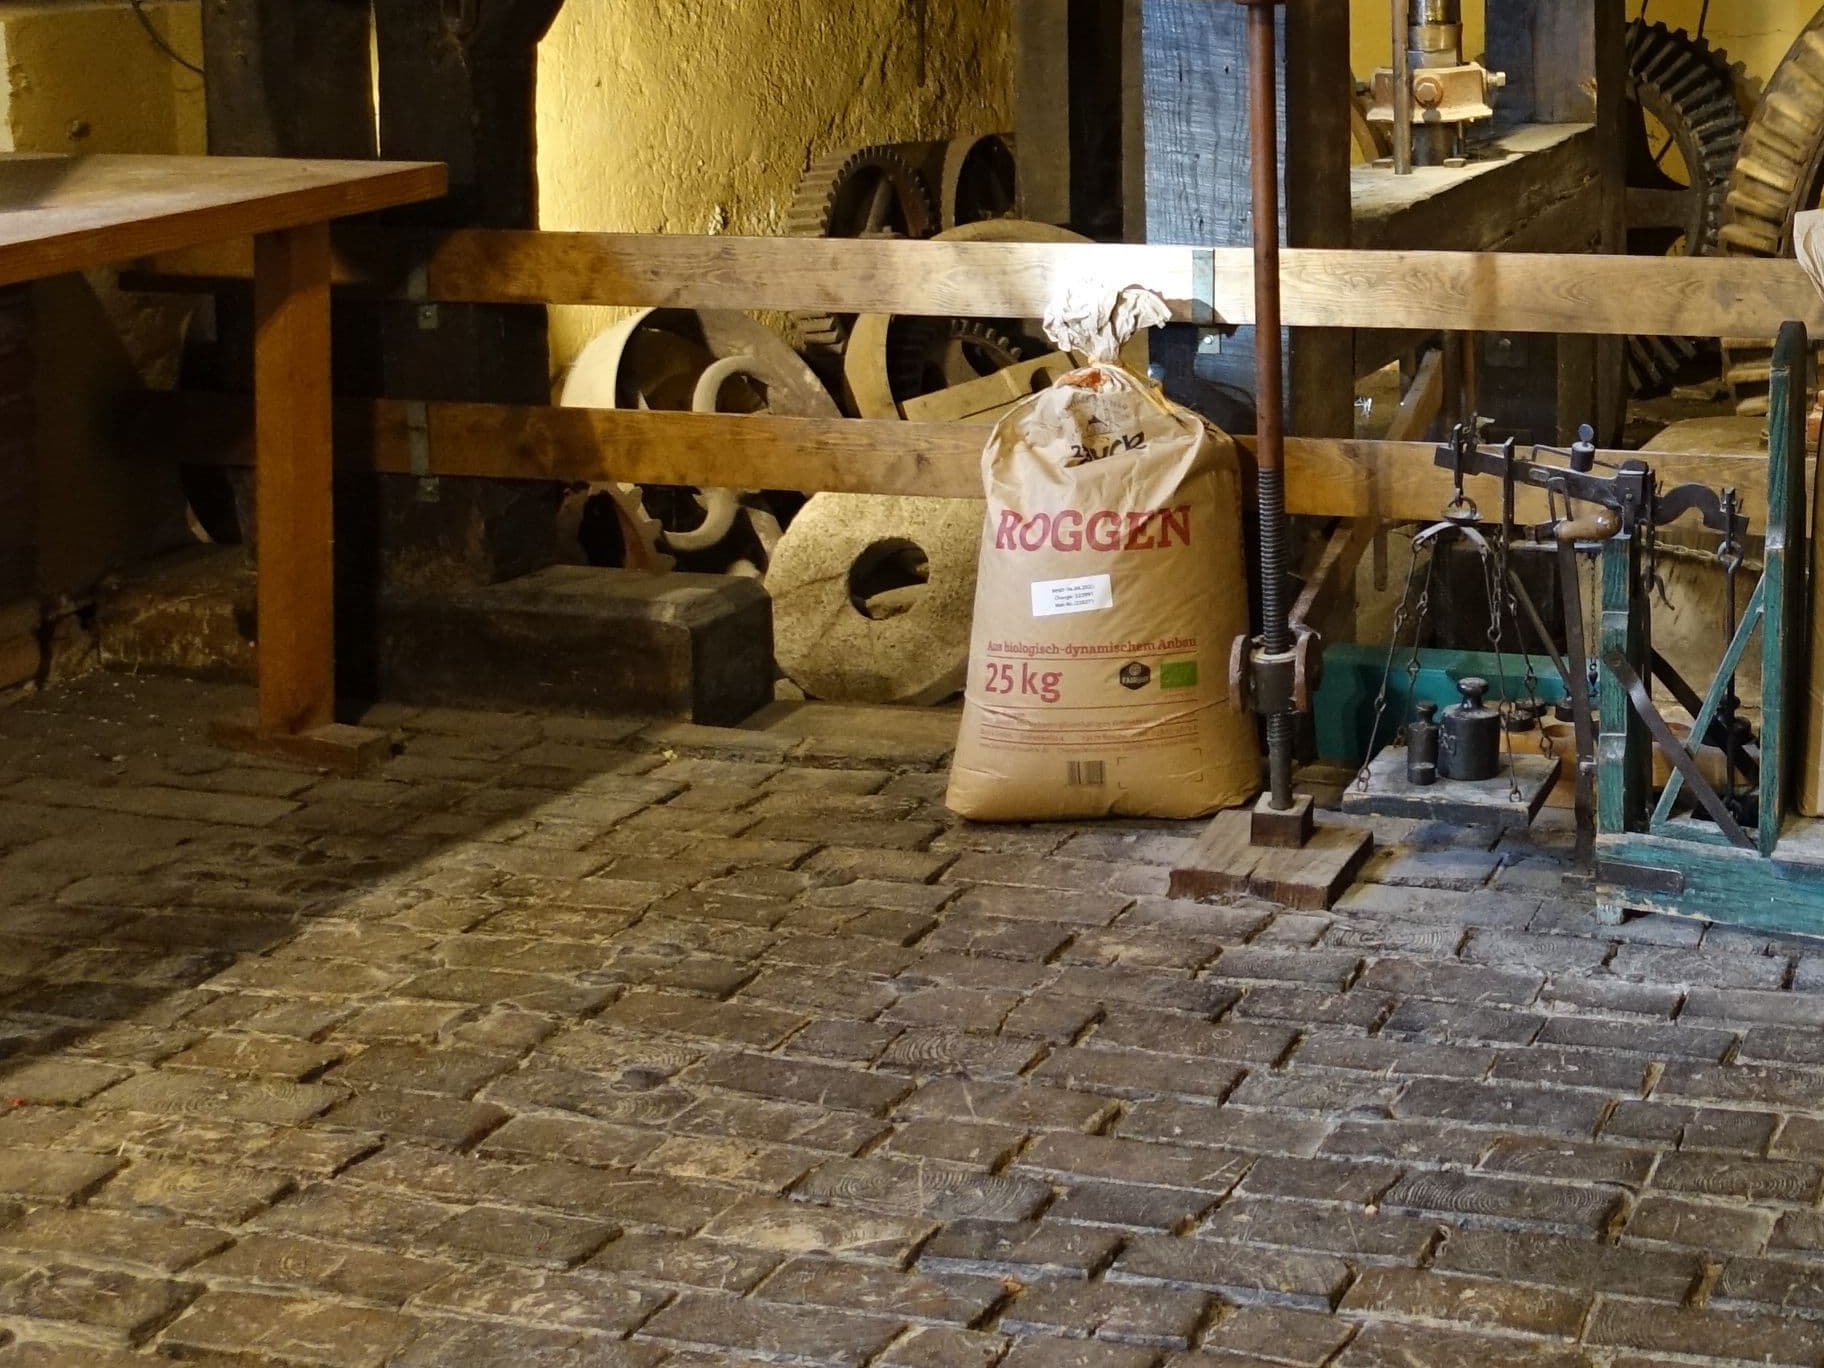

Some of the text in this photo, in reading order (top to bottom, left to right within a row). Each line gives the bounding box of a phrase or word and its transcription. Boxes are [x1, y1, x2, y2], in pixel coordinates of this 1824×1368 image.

[995, 505, 1191, 552] ROGGEN
[1157, 636, 1197, 651] Anbau
[985, 661, 1064, 704] 25 kg
